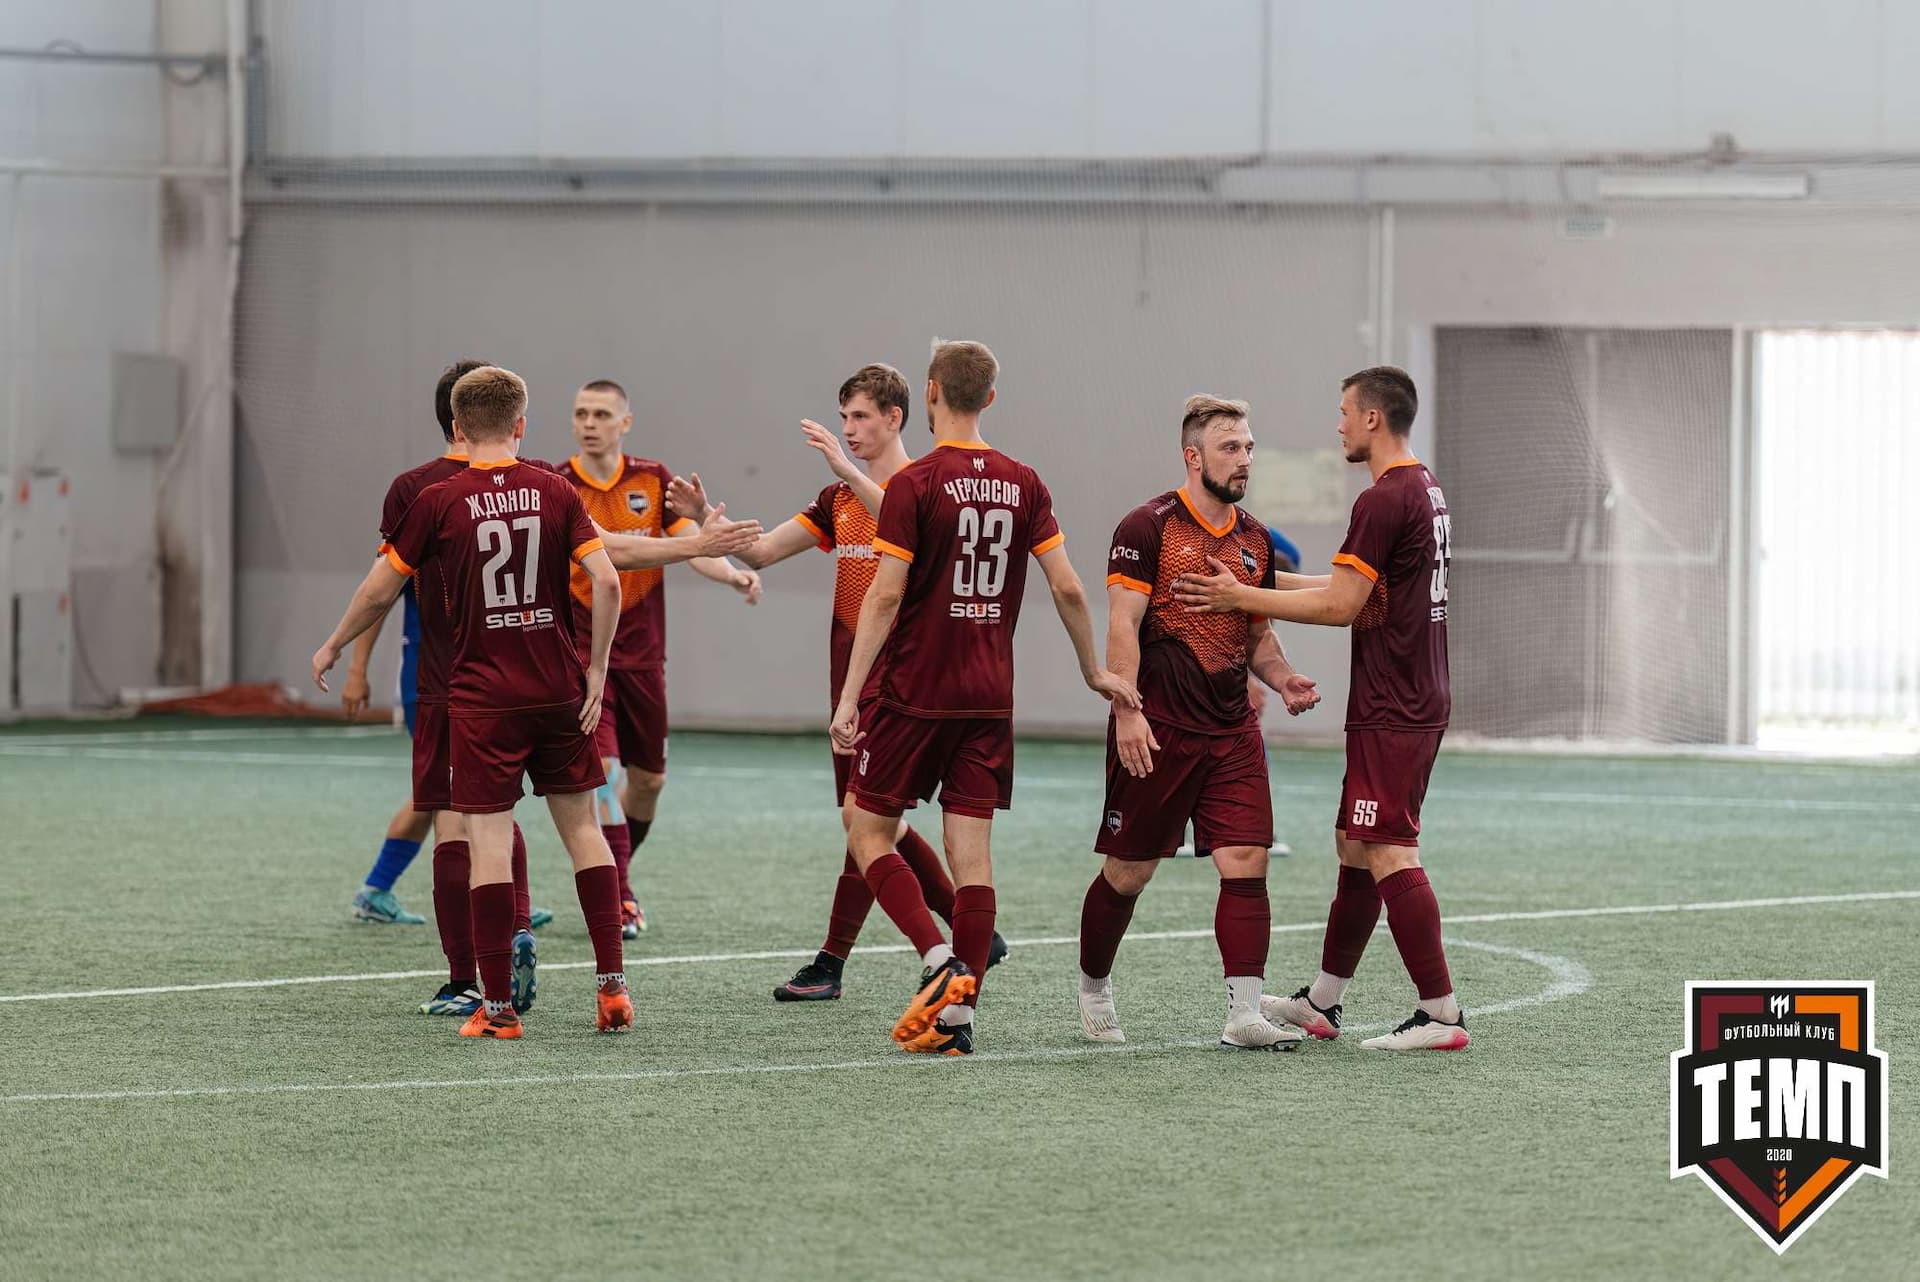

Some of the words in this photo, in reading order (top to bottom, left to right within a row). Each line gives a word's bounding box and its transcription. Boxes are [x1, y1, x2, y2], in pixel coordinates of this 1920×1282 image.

[465, 488, 541, 520] ЖДАНОВ
[477, 516, 541, 609] 27
[953, 507, 1013, 597] 33
[485, 607, 554, 629] SEUS
[949, 602, 1001, 618] SEUS
[1352, 799, 1379, 827] 55
